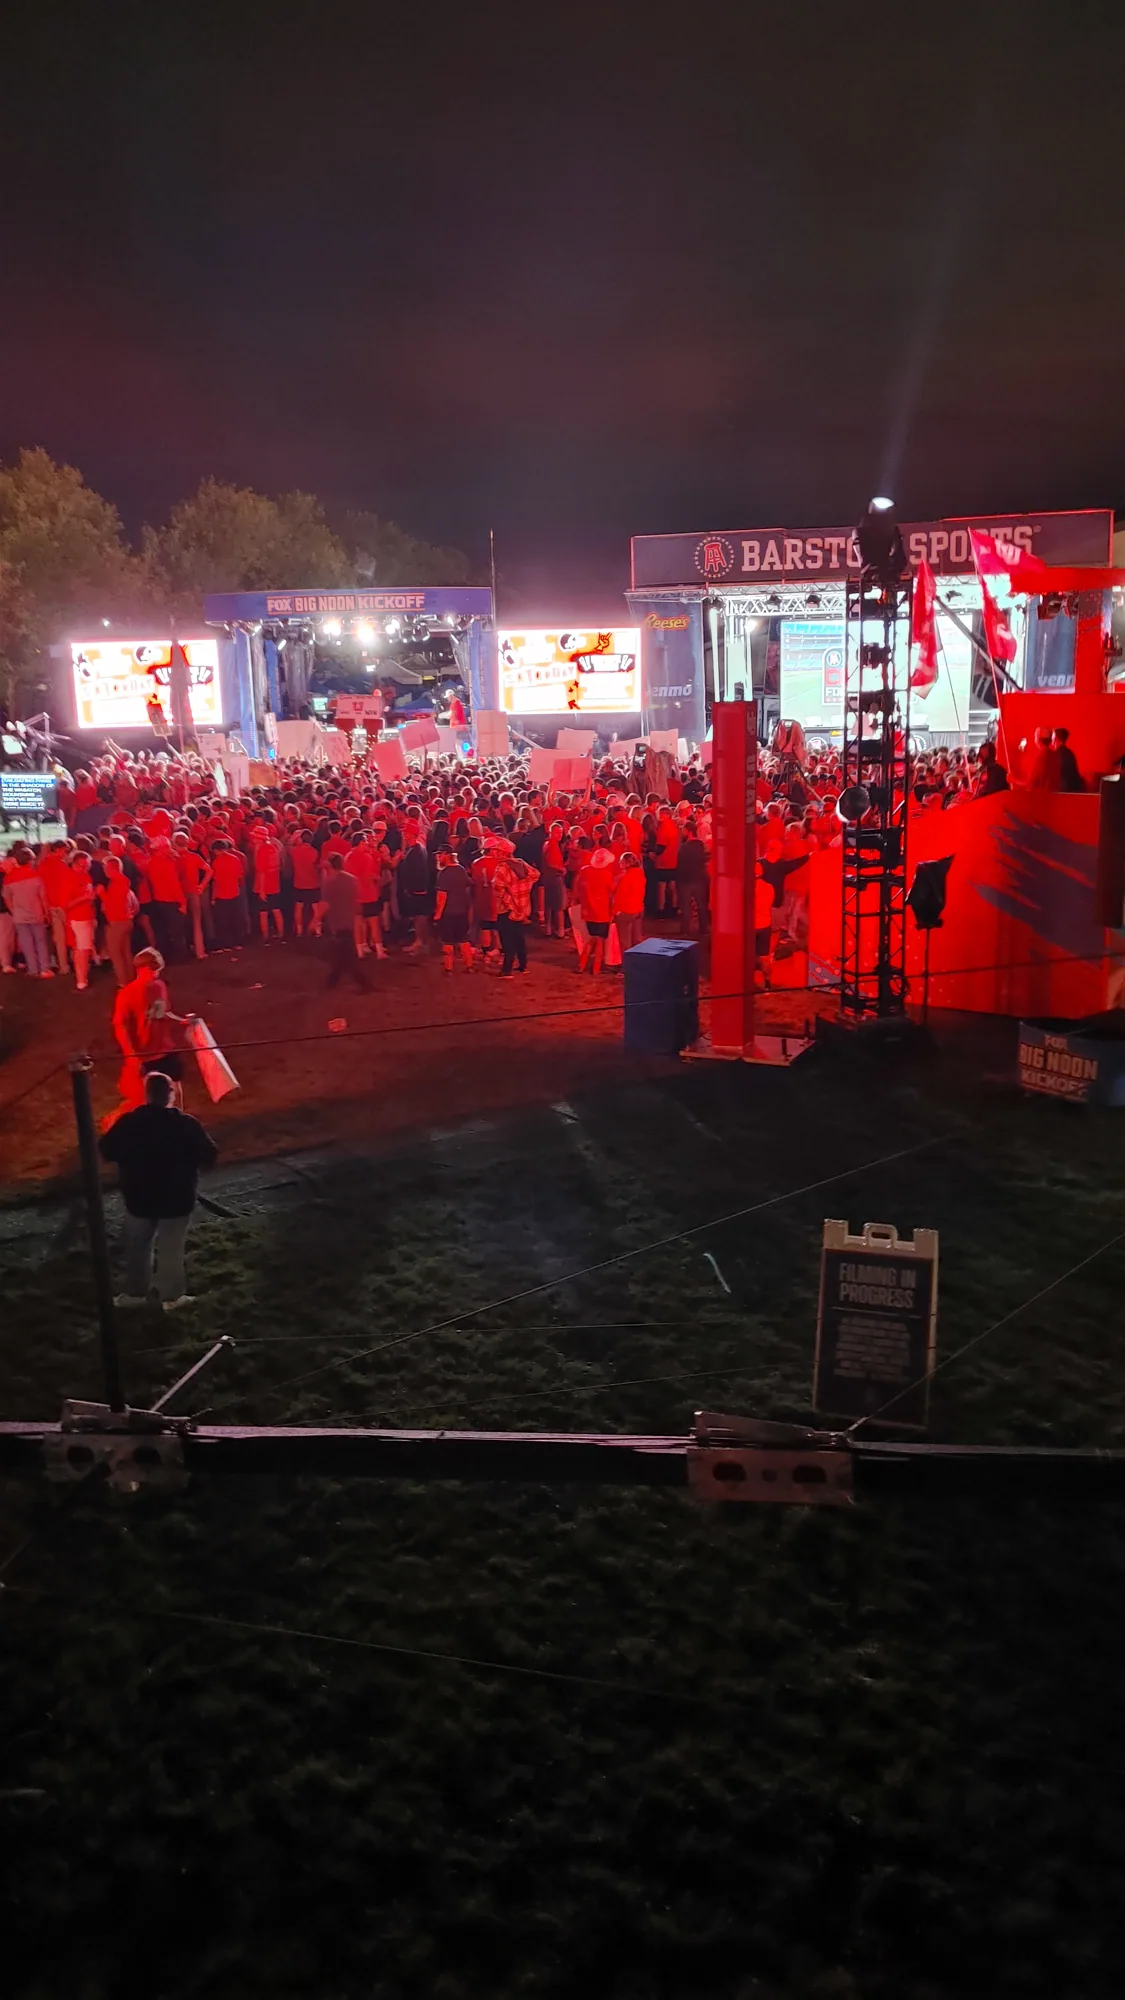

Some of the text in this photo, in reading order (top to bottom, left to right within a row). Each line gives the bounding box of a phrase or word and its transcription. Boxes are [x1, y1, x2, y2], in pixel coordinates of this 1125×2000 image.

[741, 537, 862, 572] BARSTO
[267, 595, 425, 612] FOX BIG NOON KICKOFF
[645, 611, 690, 630] Reese's
[1019, 1043, 1098, 1080] BIG NOON
[839, 1262, 917, 1289] FILMING IN
[839, 1281, 915, 1309] PROGRESS
